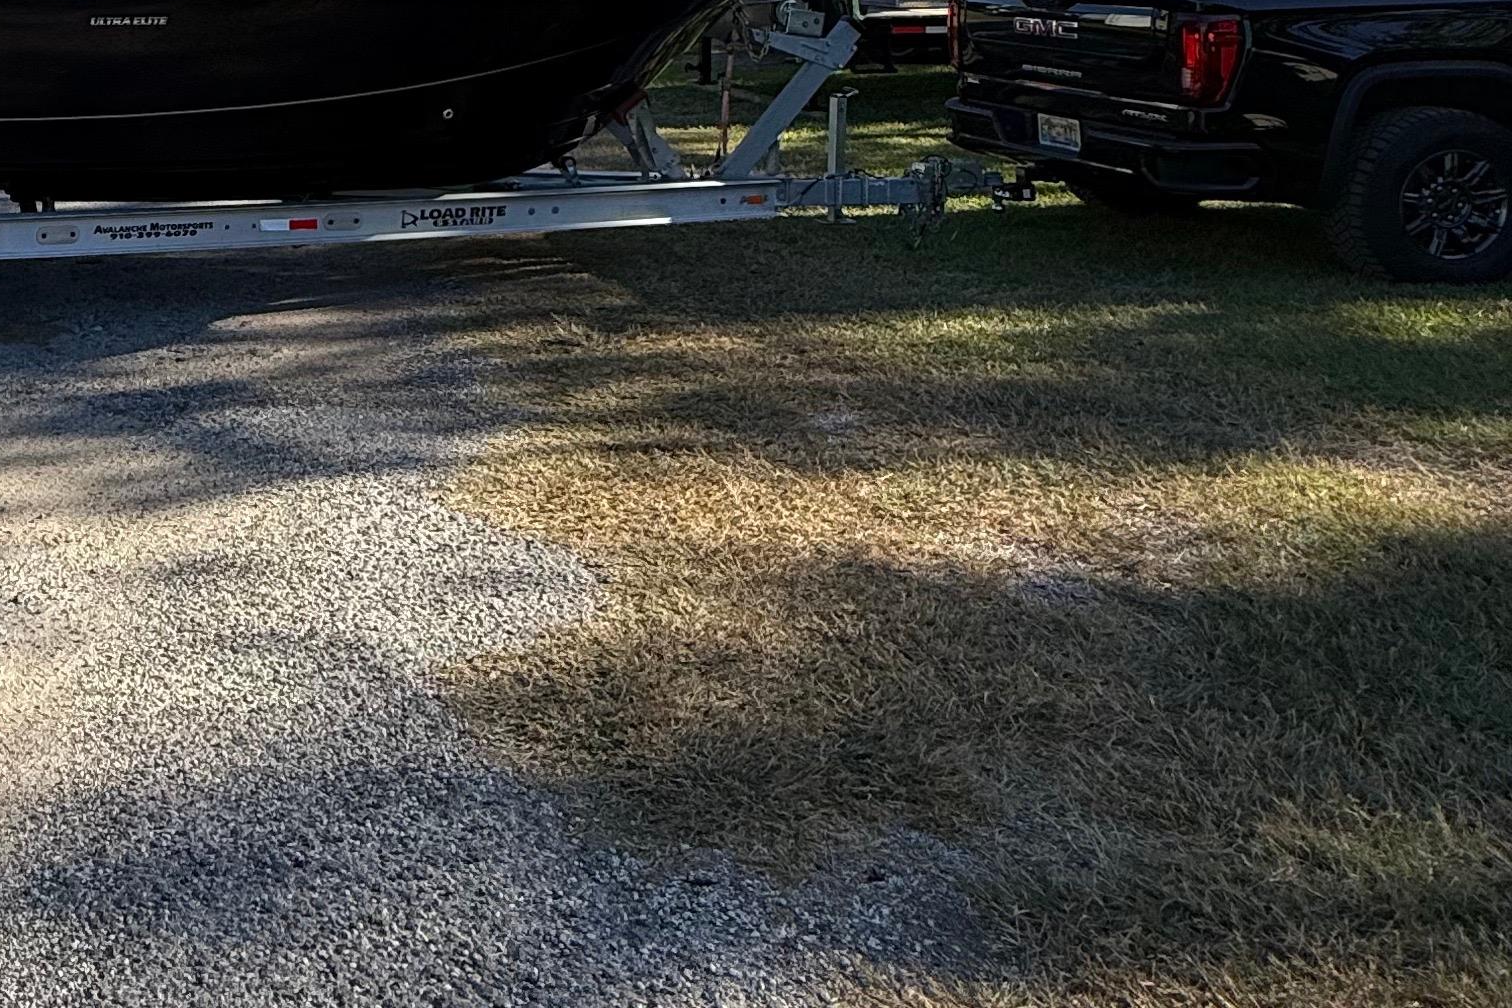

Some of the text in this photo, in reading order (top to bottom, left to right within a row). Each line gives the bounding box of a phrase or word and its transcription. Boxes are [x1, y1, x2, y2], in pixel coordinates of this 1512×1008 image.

[90, 16, 169, 26] ULTRA ELITE
[1013, 16, 1080, 40] GMC
[420, 205, 507, 221] LOAD RITE
